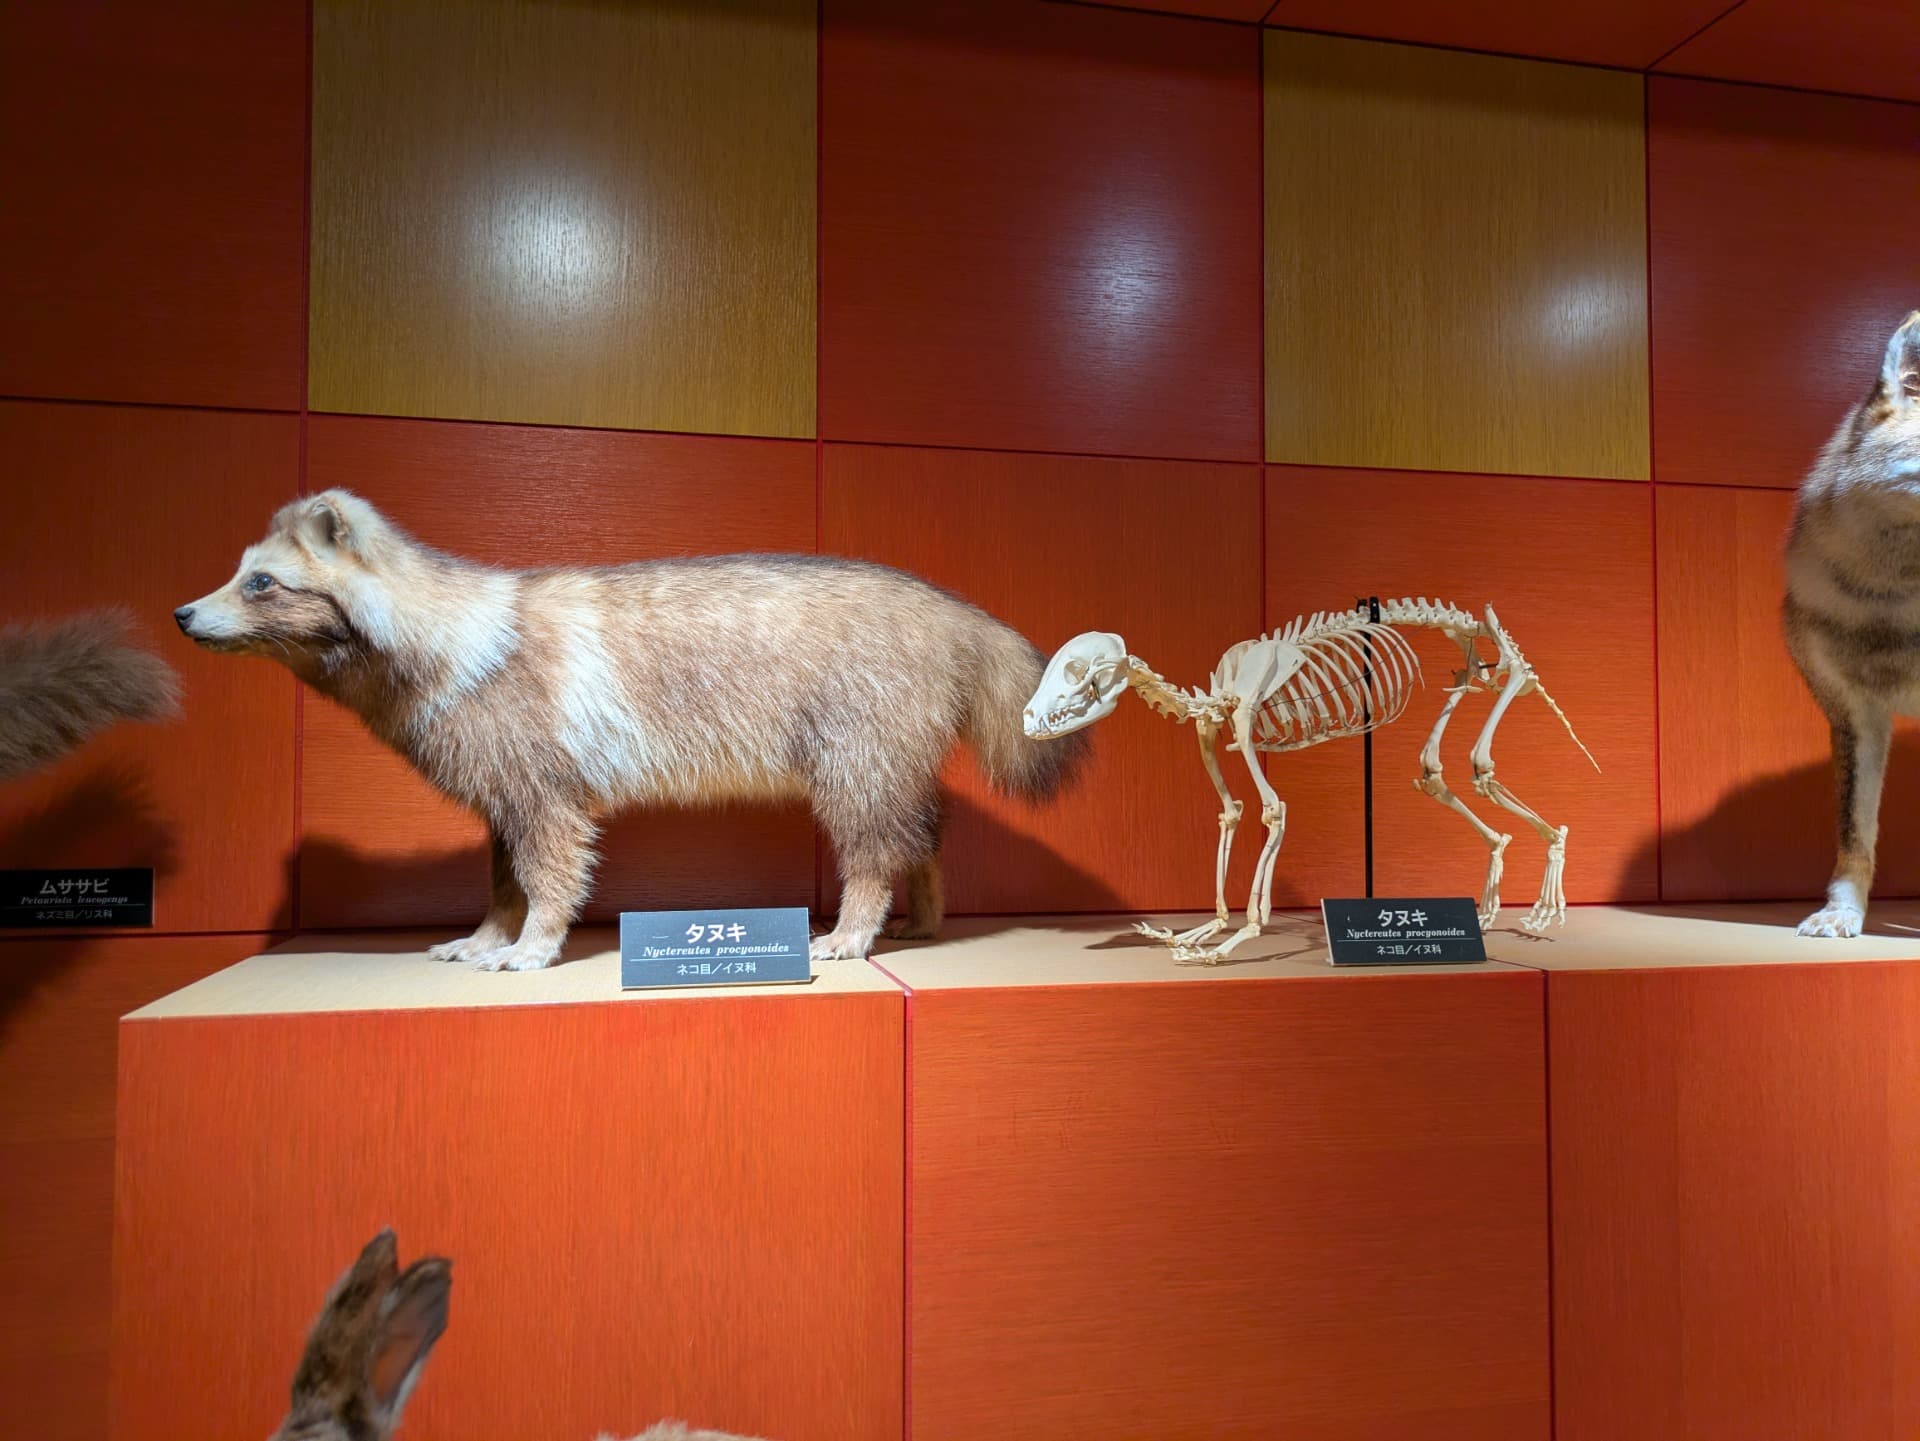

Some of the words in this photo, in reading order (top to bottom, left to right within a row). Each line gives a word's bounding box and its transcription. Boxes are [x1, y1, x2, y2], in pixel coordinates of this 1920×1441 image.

[39, 878, 110, 895] ムササビ
[1377, 908, 1429, 927] タヌキ
[685, 923, 747, 944] タヌキ
[1346, 928, 1402, 939] Nyctereutes
[1405, 927, 1466, 939] procyonoides
[642, 945, 711, 958] Nyctereutes
[716, 942, 790, 957] procyonoides
